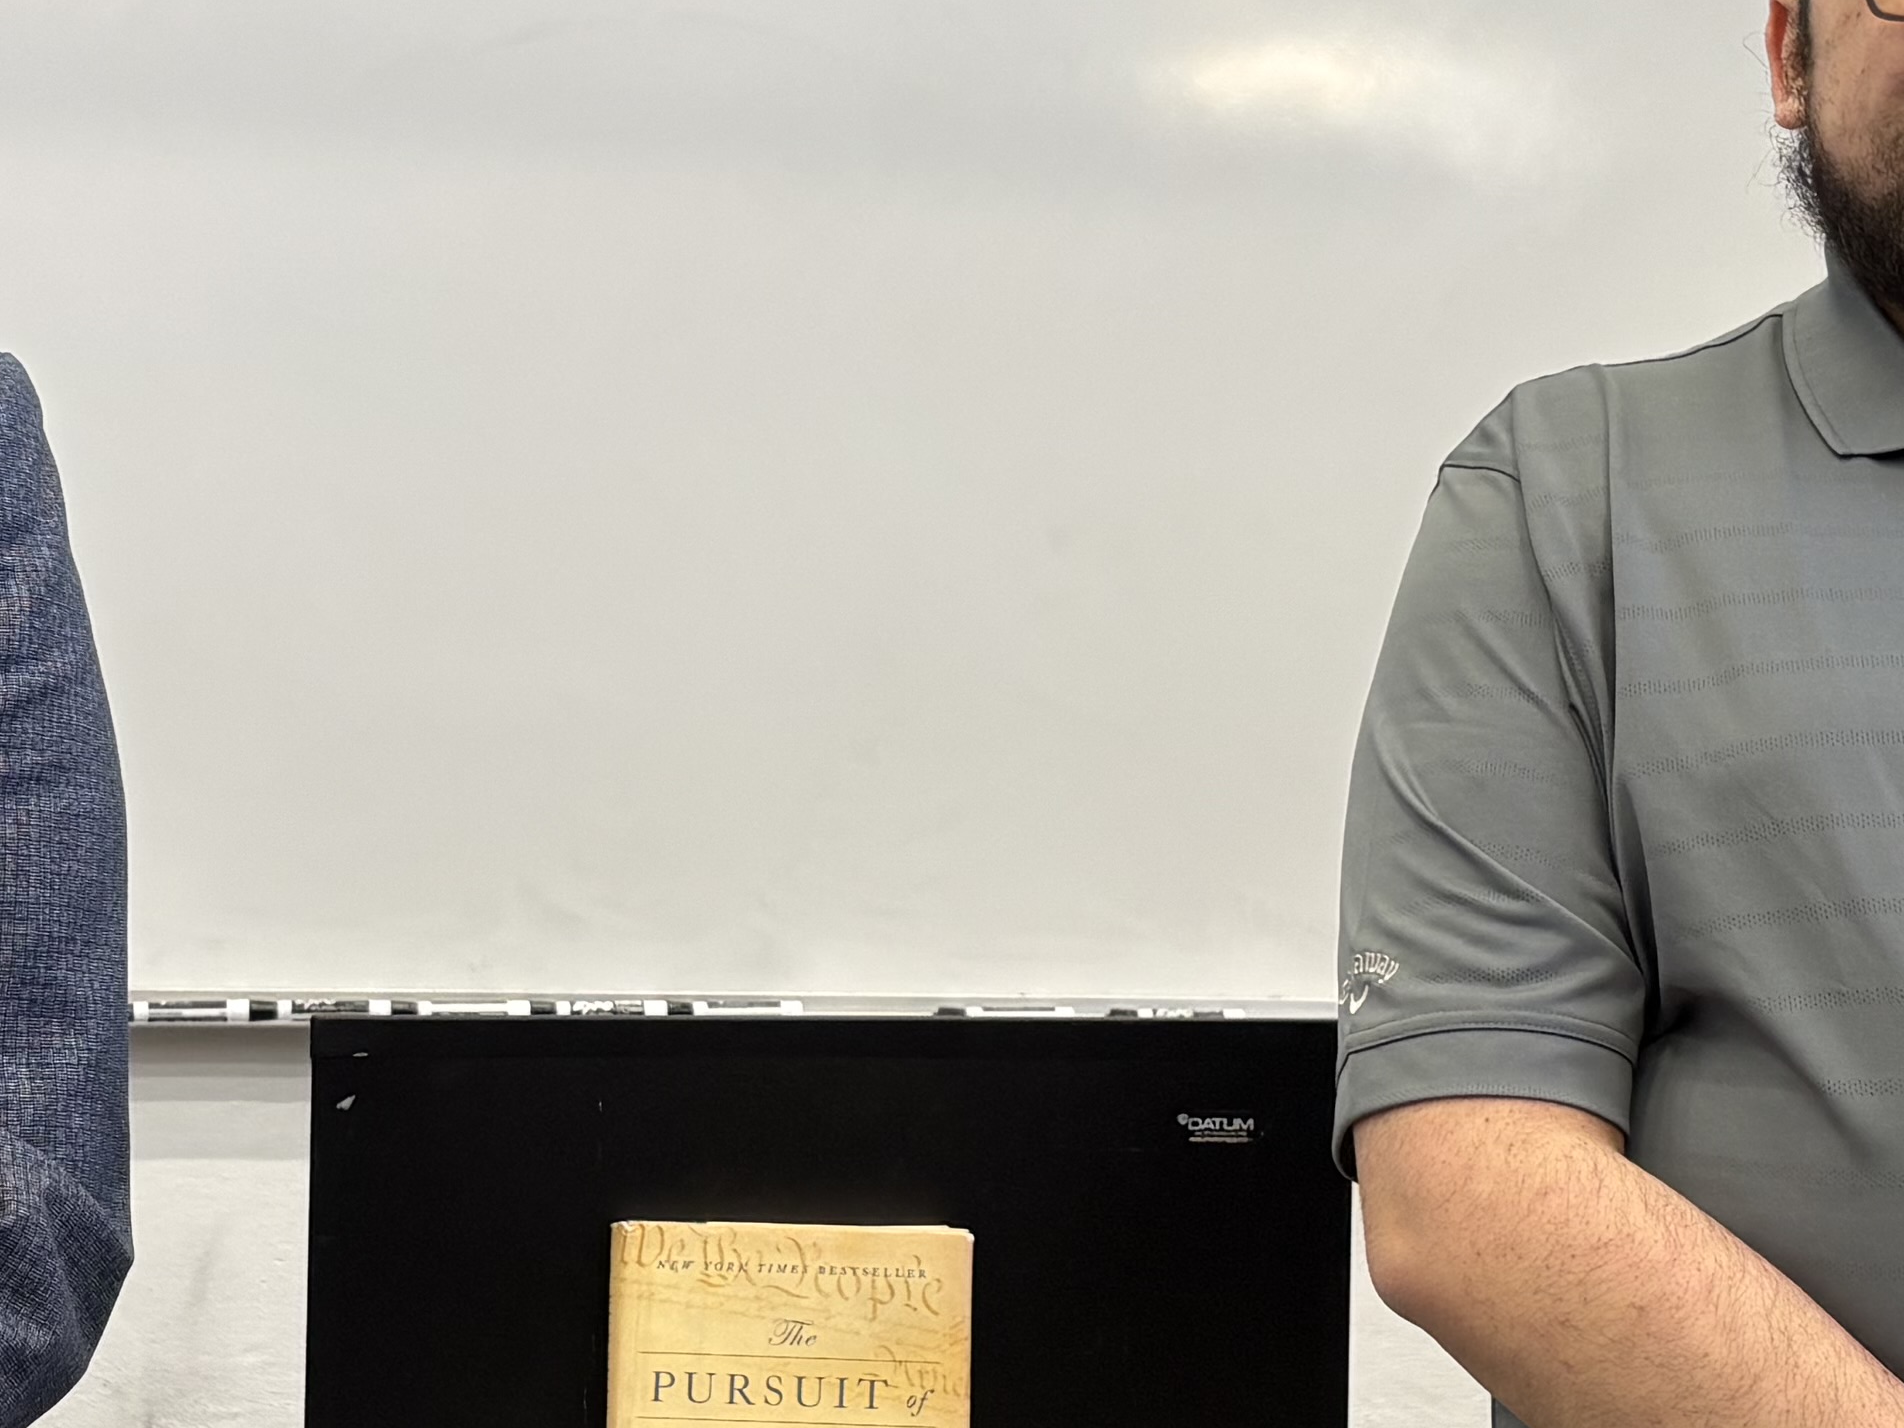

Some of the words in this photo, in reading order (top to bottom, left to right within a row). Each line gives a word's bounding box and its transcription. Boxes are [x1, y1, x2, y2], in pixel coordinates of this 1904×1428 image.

[1188, 1117, 1254, 1130] DATUM
[656, 1260, 695, 1272] NEW
[703, 1261, 750, 1273] YORK
[757, 1263, 808, 1274] TIMES
[817, 1265, 927, 1278] BESTSELLER
[768, 1319, 817, 1347] The
[652, 1371, 889, 1410] PURSUIT
[906, 1389, 935, 1417] of
